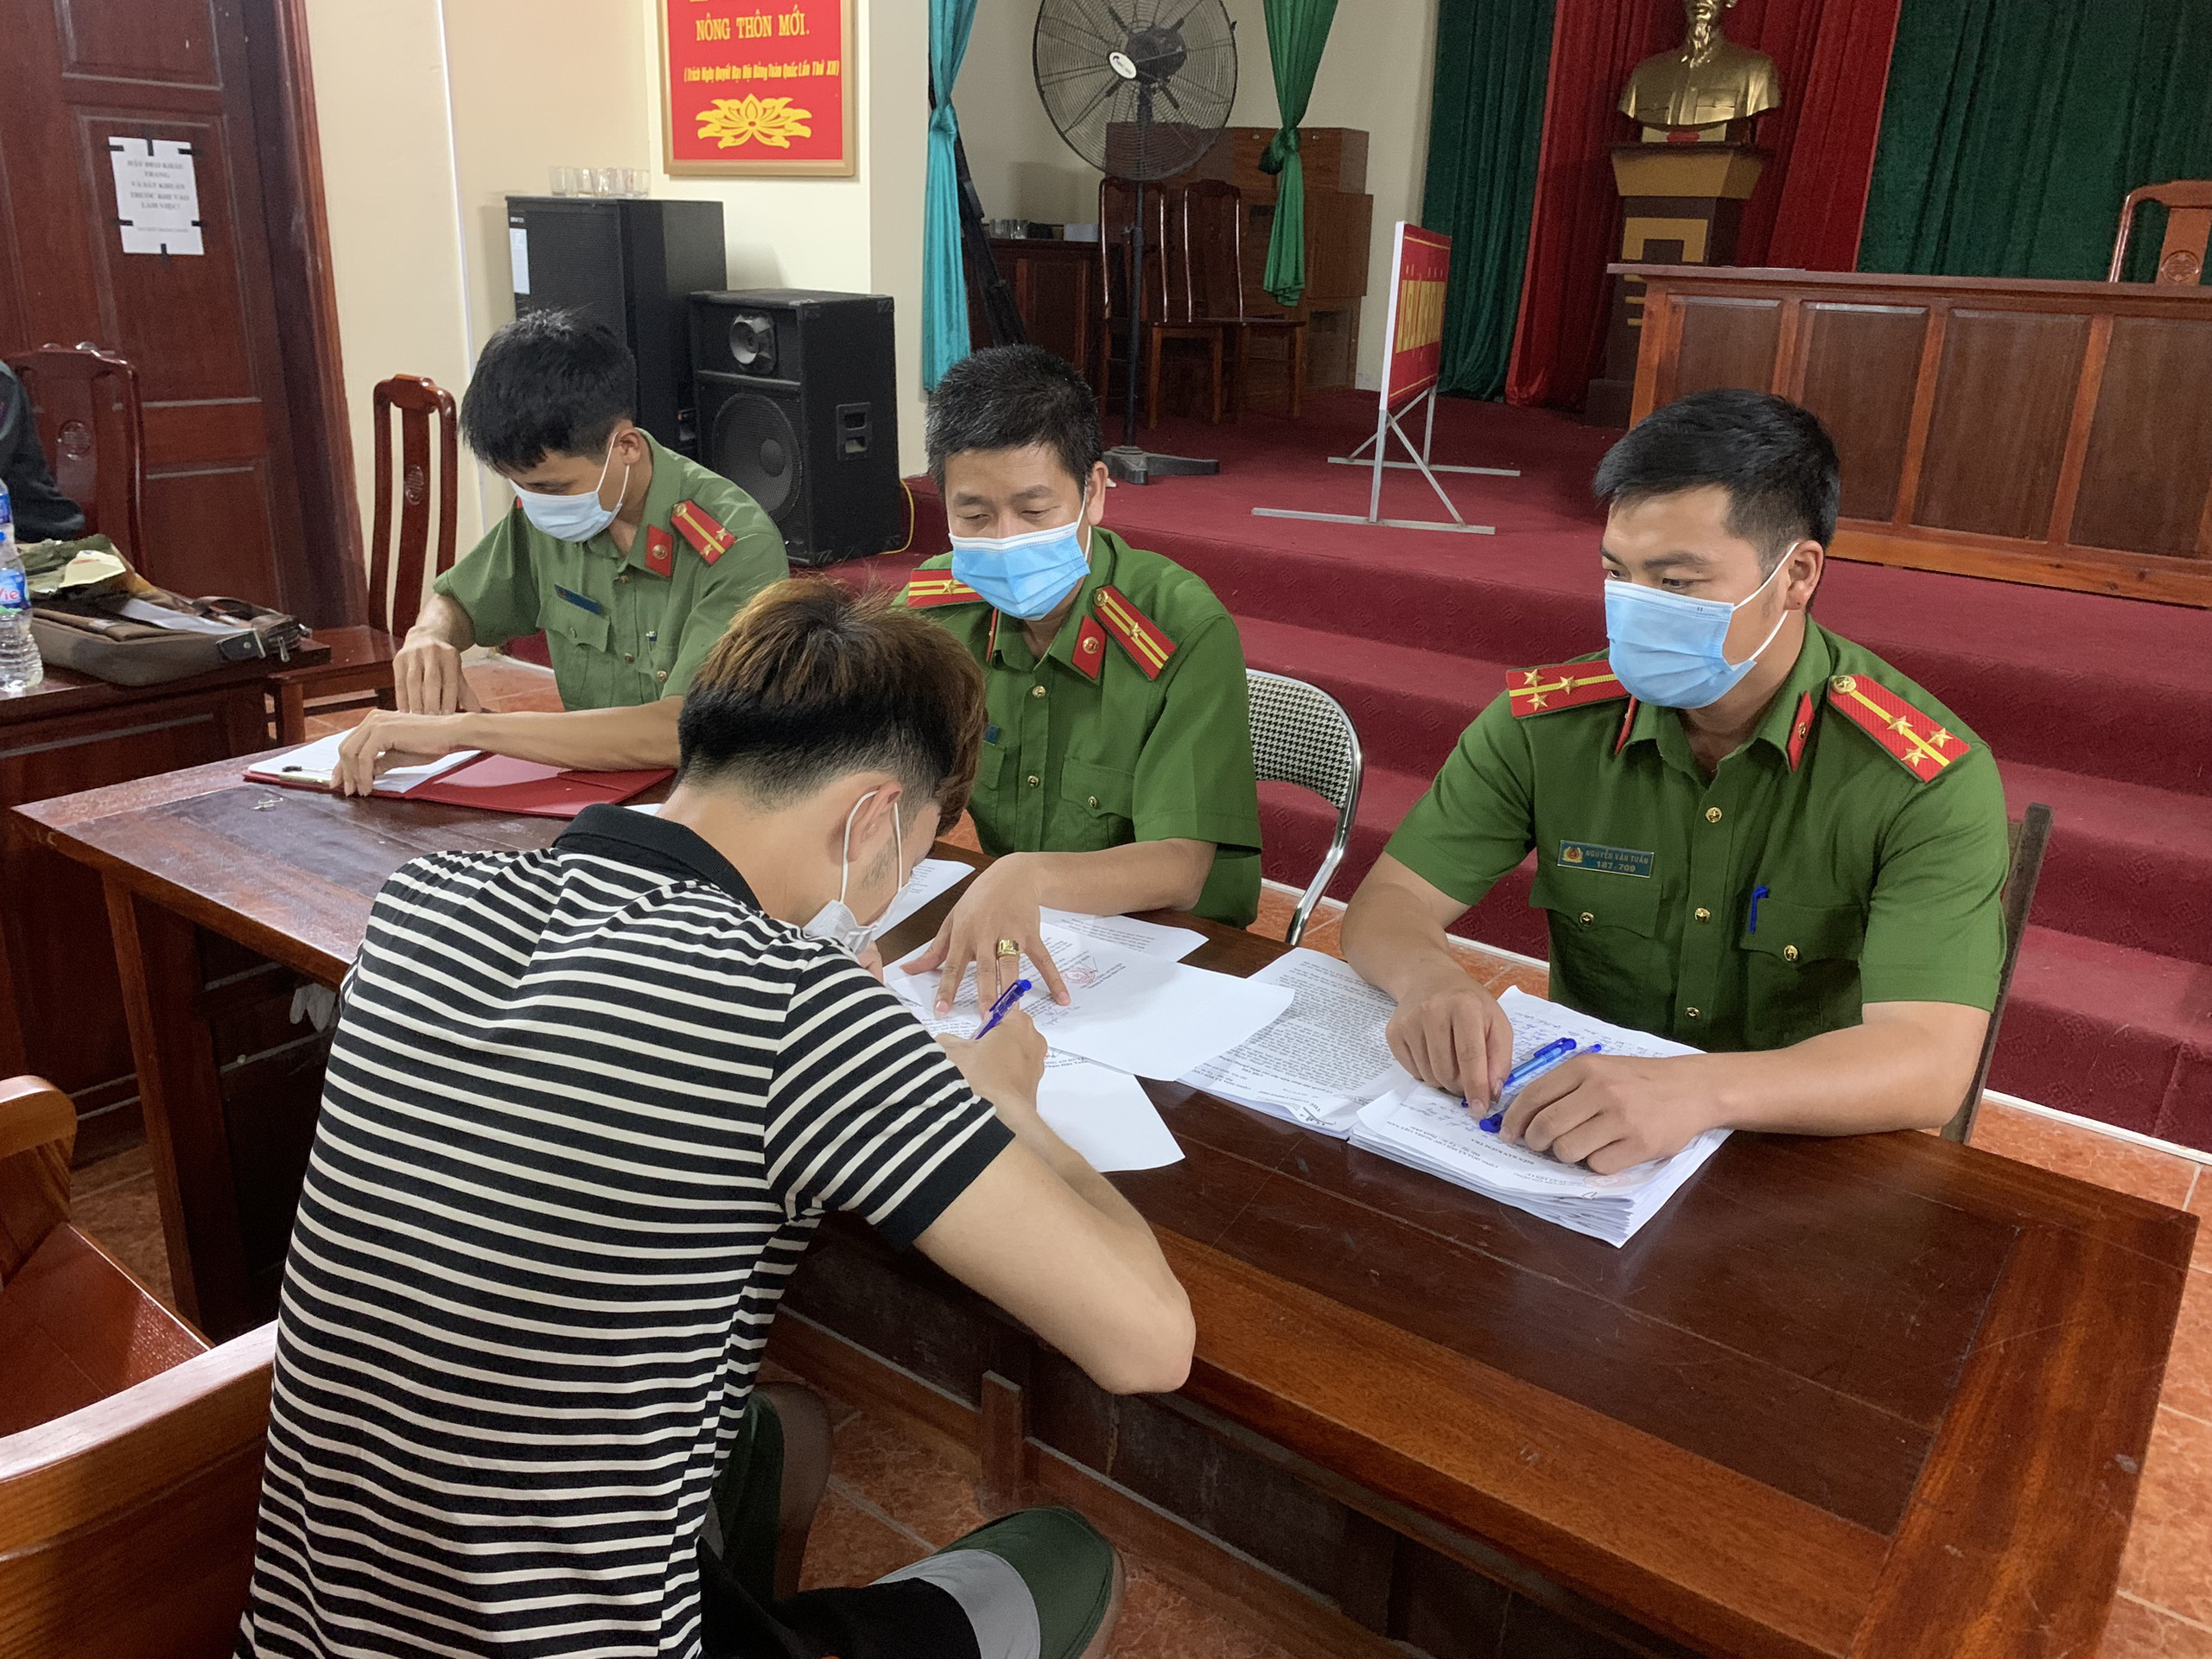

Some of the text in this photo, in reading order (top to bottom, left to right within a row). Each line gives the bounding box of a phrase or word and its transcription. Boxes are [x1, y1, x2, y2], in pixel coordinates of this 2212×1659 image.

[696, 4, 810, 41] NÔNG THÔN MỚI.
[1586, 849, 1612, 859] NGUYỄN
[1615, 853, 1629, 862] VĂN
